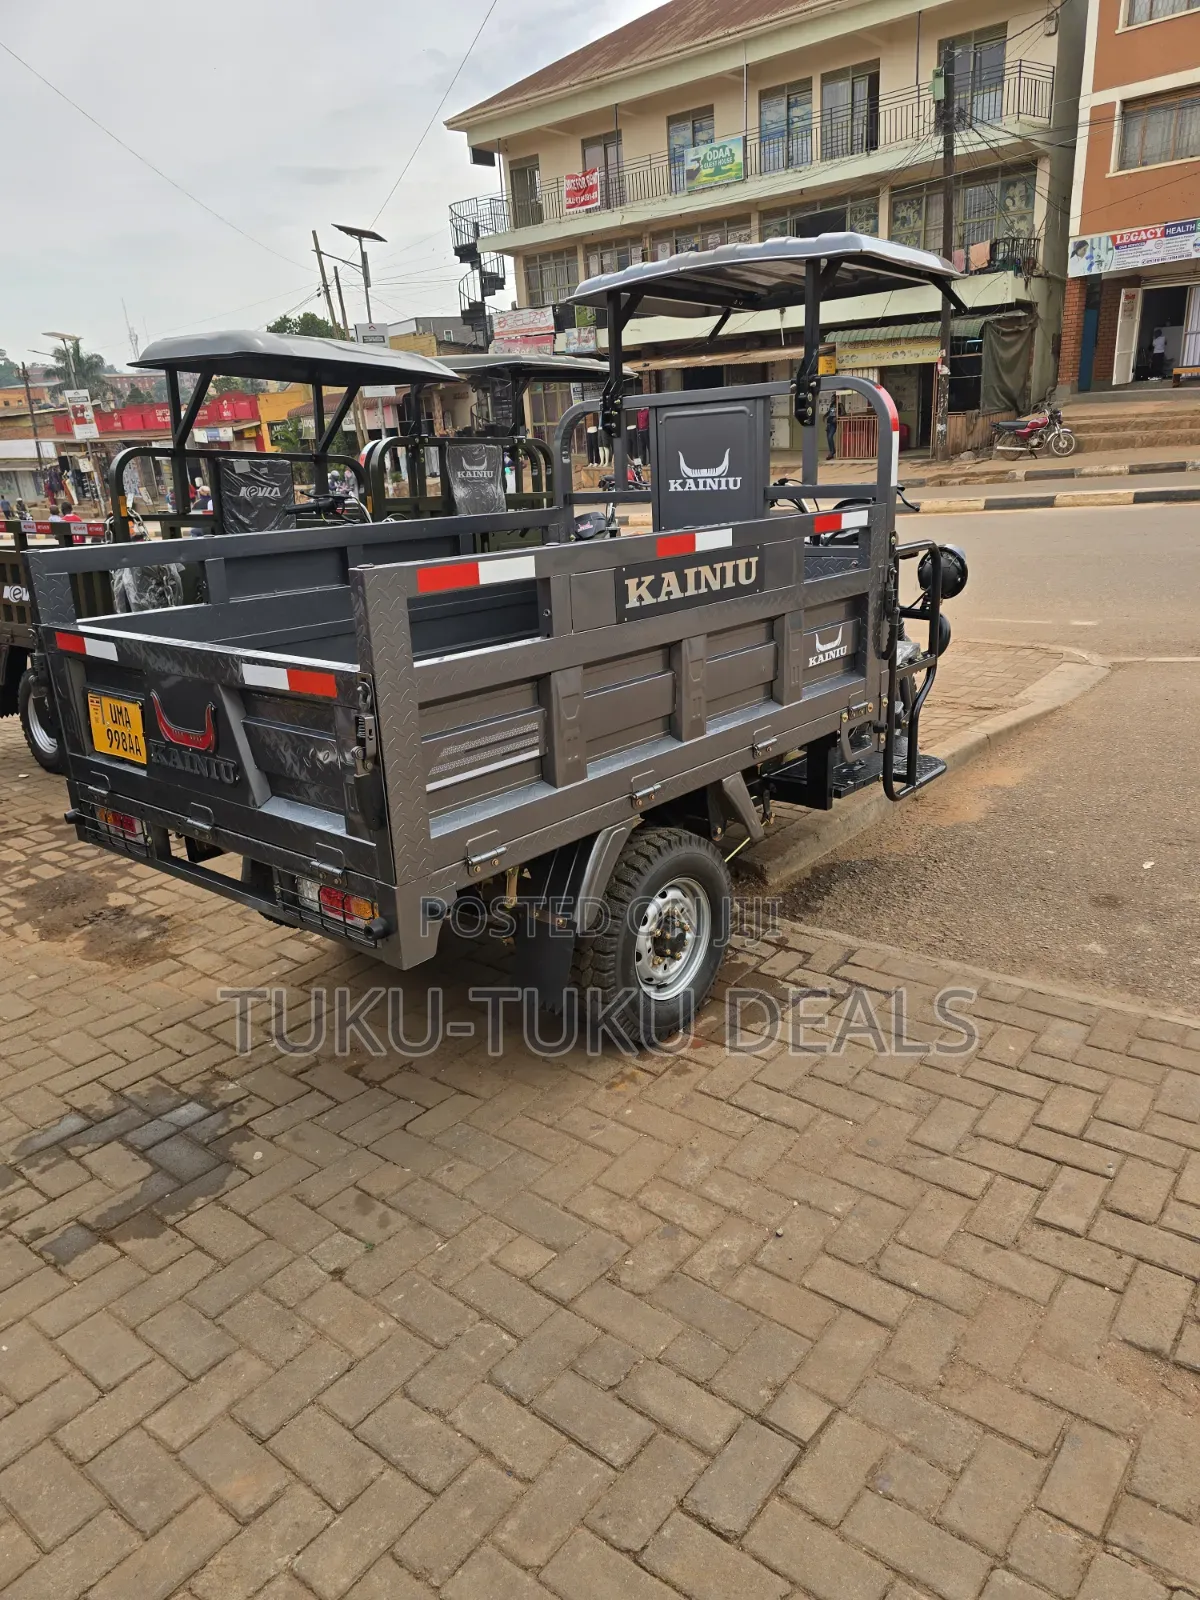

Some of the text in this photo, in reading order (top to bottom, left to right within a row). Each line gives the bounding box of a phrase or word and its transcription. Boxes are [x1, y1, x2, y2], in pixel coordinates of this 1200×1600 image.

[706, 147, 731, 162] ODAA
[718, 157, 733, 167] HOUSE
[1115, 227, 1164, 245] LEGACY
[1166, 224, 1196, 235] HEALTH
[457, 470, 494, 478] KAINIU
[668, 476, 742, 492] KAINIU
[624, 556, 759, 609] KAINIU
[808, 645, 848, 668] KAINIU
[109, 703, 132, 729] UMA
[106, 728, 142, 757] 998AA
[151, 743, 235, 784] KAINIU
